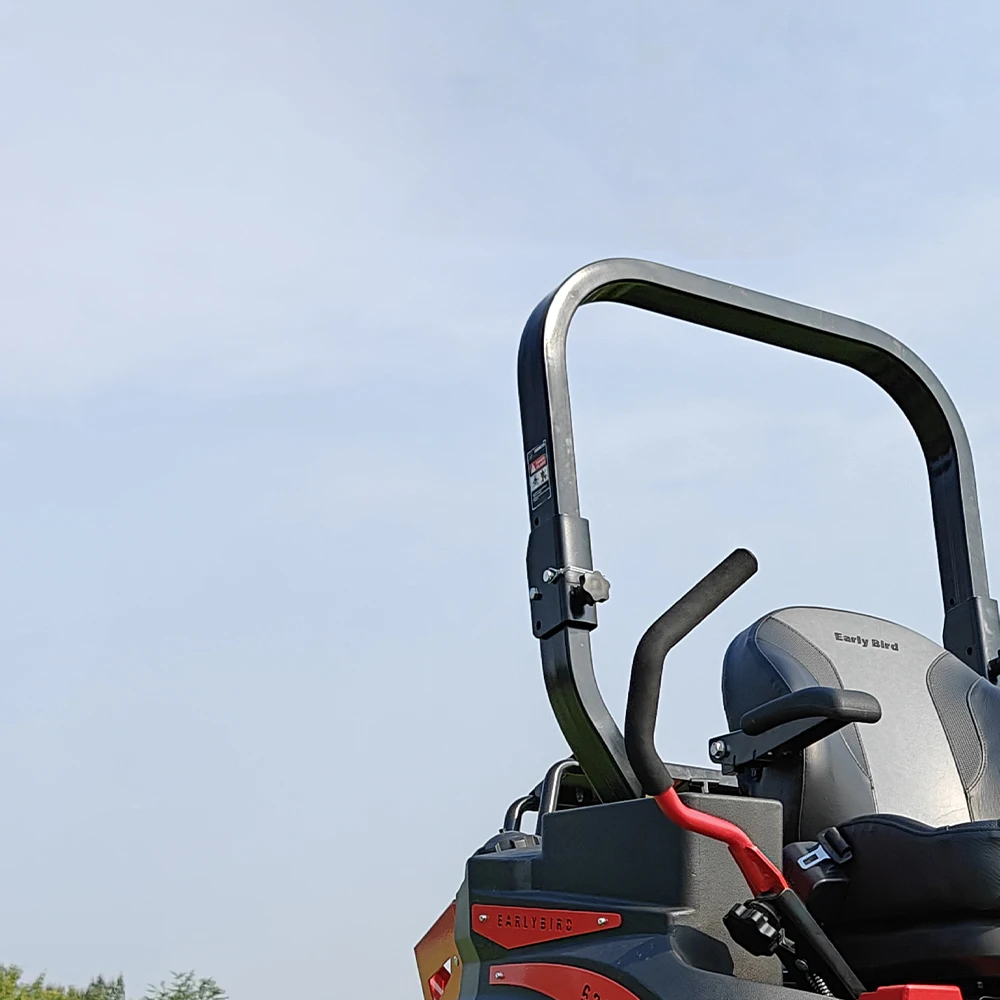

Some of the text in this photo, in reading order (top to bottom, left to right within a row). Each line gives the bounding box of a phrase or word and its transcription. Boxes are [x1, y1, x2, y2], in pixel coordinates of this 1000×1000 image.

[834, 632, 899, 652] Early Bird
[497, 914, 573, 931] EARLYBIRD
